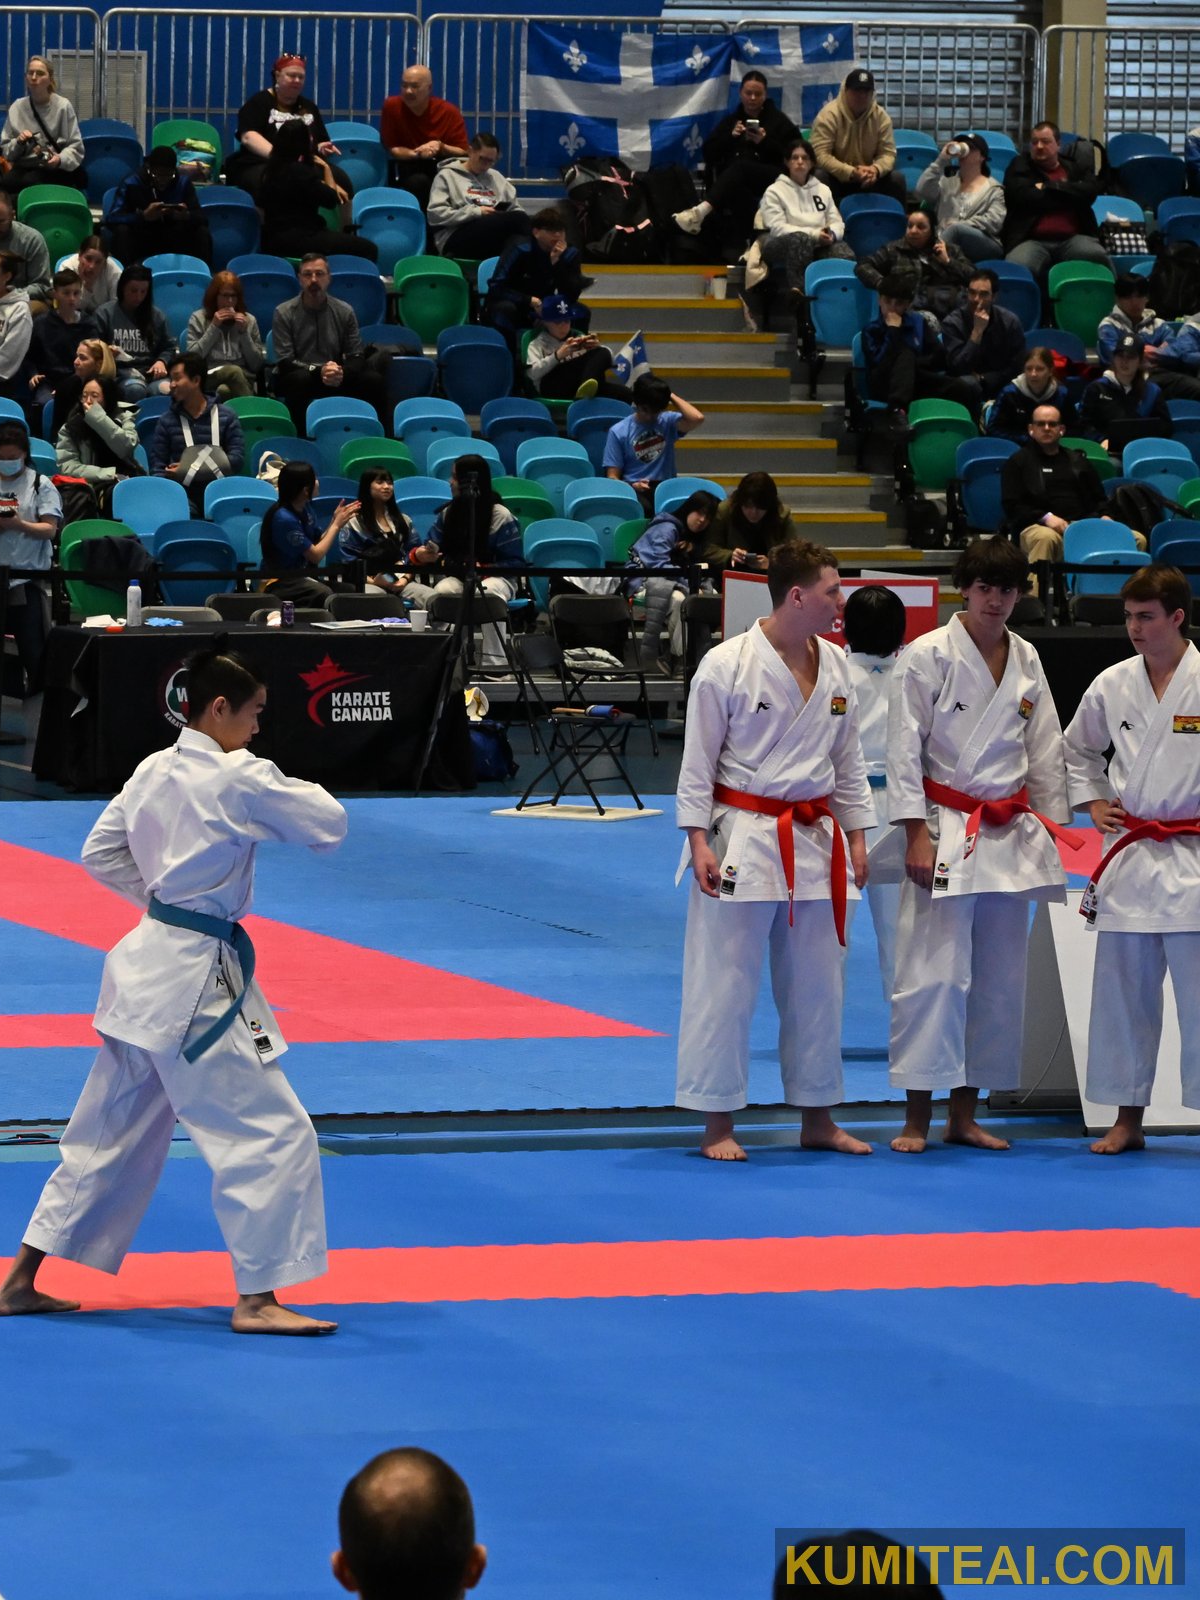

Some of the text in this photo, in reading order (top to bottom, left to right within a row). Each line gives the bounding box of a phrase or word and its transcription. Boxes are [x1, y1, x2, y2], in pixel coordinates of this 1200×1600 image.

[813, 195, 826, 212] B
[113, 328, 141, 340] MAKE
[332, 692, 391, 706] KARATE
[332, 707, 393, 722] CANADA
